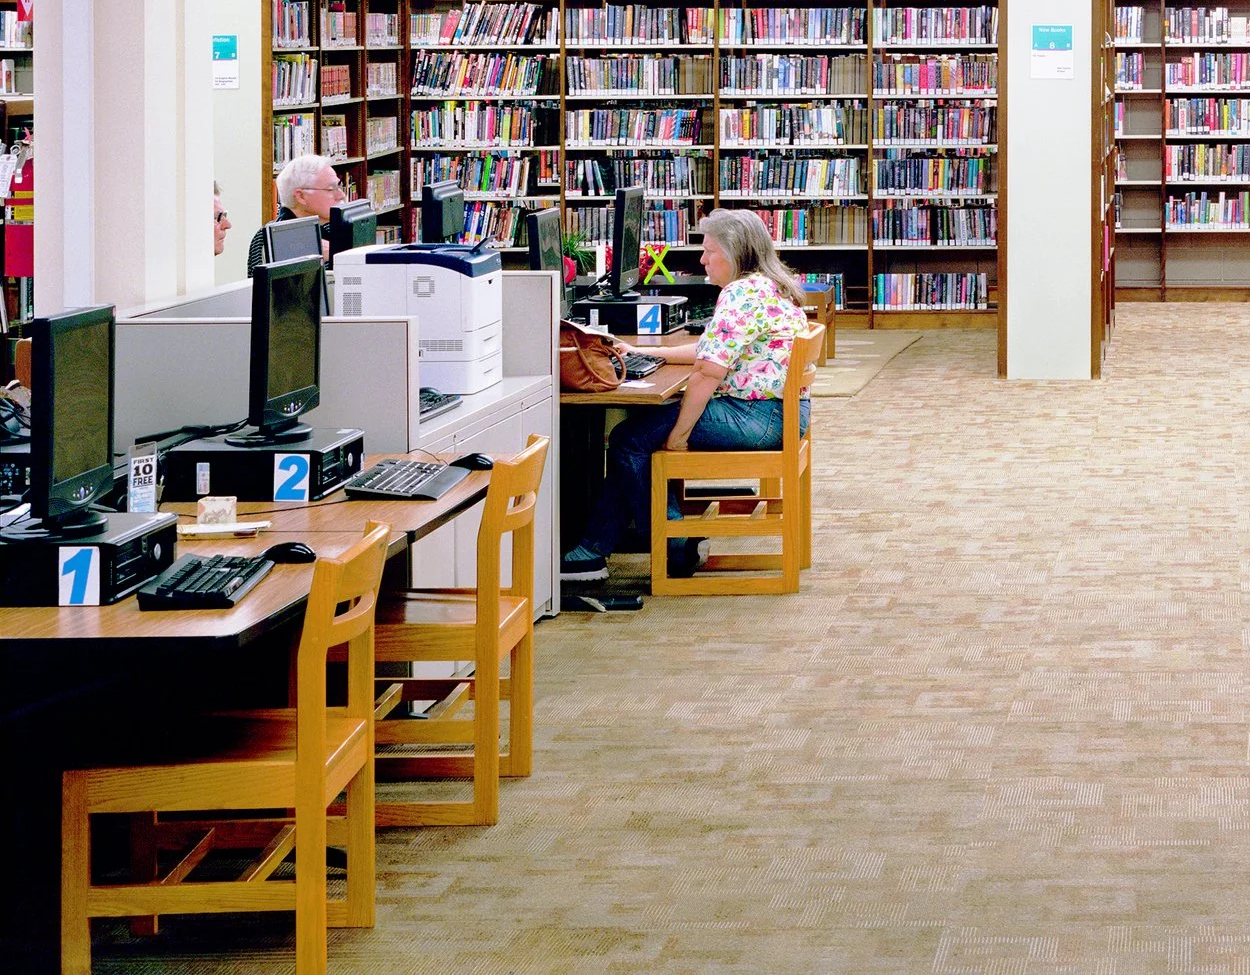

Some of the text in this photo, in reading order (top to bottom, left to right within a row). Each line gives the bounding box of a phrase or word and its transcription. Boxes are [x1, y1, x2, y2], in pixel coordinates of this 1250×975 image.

[1049, 41, 1056, 49] 8
[214, 51, 221, 59] 7
[638, 305, 661, 333] 4
[133, 463, 153, 477] 10
[132, 476, 153, 486] FREE
[275, 455, 309, 500] 2
[61, 548, 94, 604] 1
